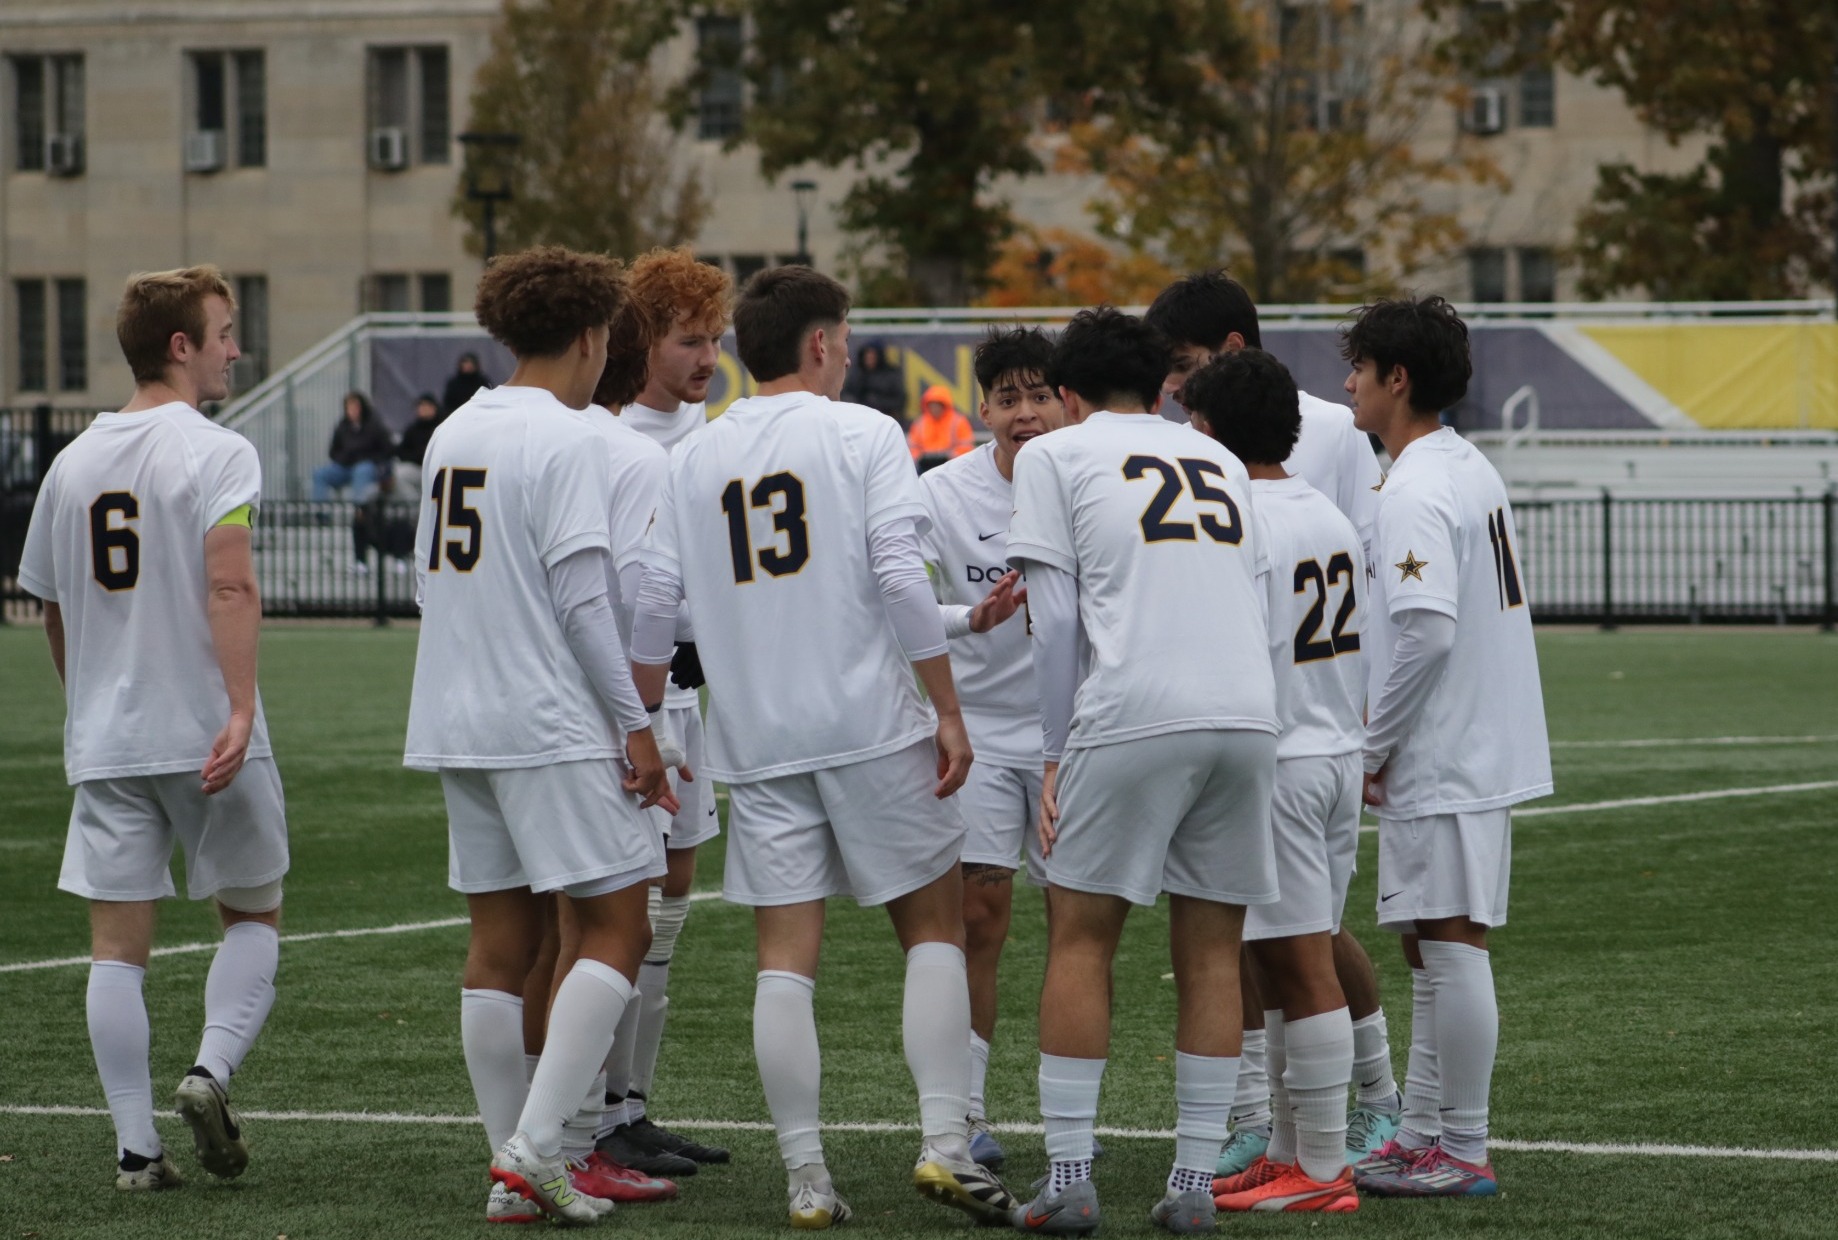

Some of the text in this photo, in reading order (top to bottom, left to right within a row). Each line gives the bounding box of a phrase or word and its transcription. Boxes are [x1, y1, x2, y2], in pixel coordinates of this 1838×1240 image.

[89, 490, 140, 592] 6
[427, 467, 487, 573] 15
[720, 469, 811, 586] 13
[1121, 454, 1243, 547] 25
[966, 565, 1026, 584] DO
[1293, 551, 1361, 665] 22
[1488, 506, 1524, 611] 11
